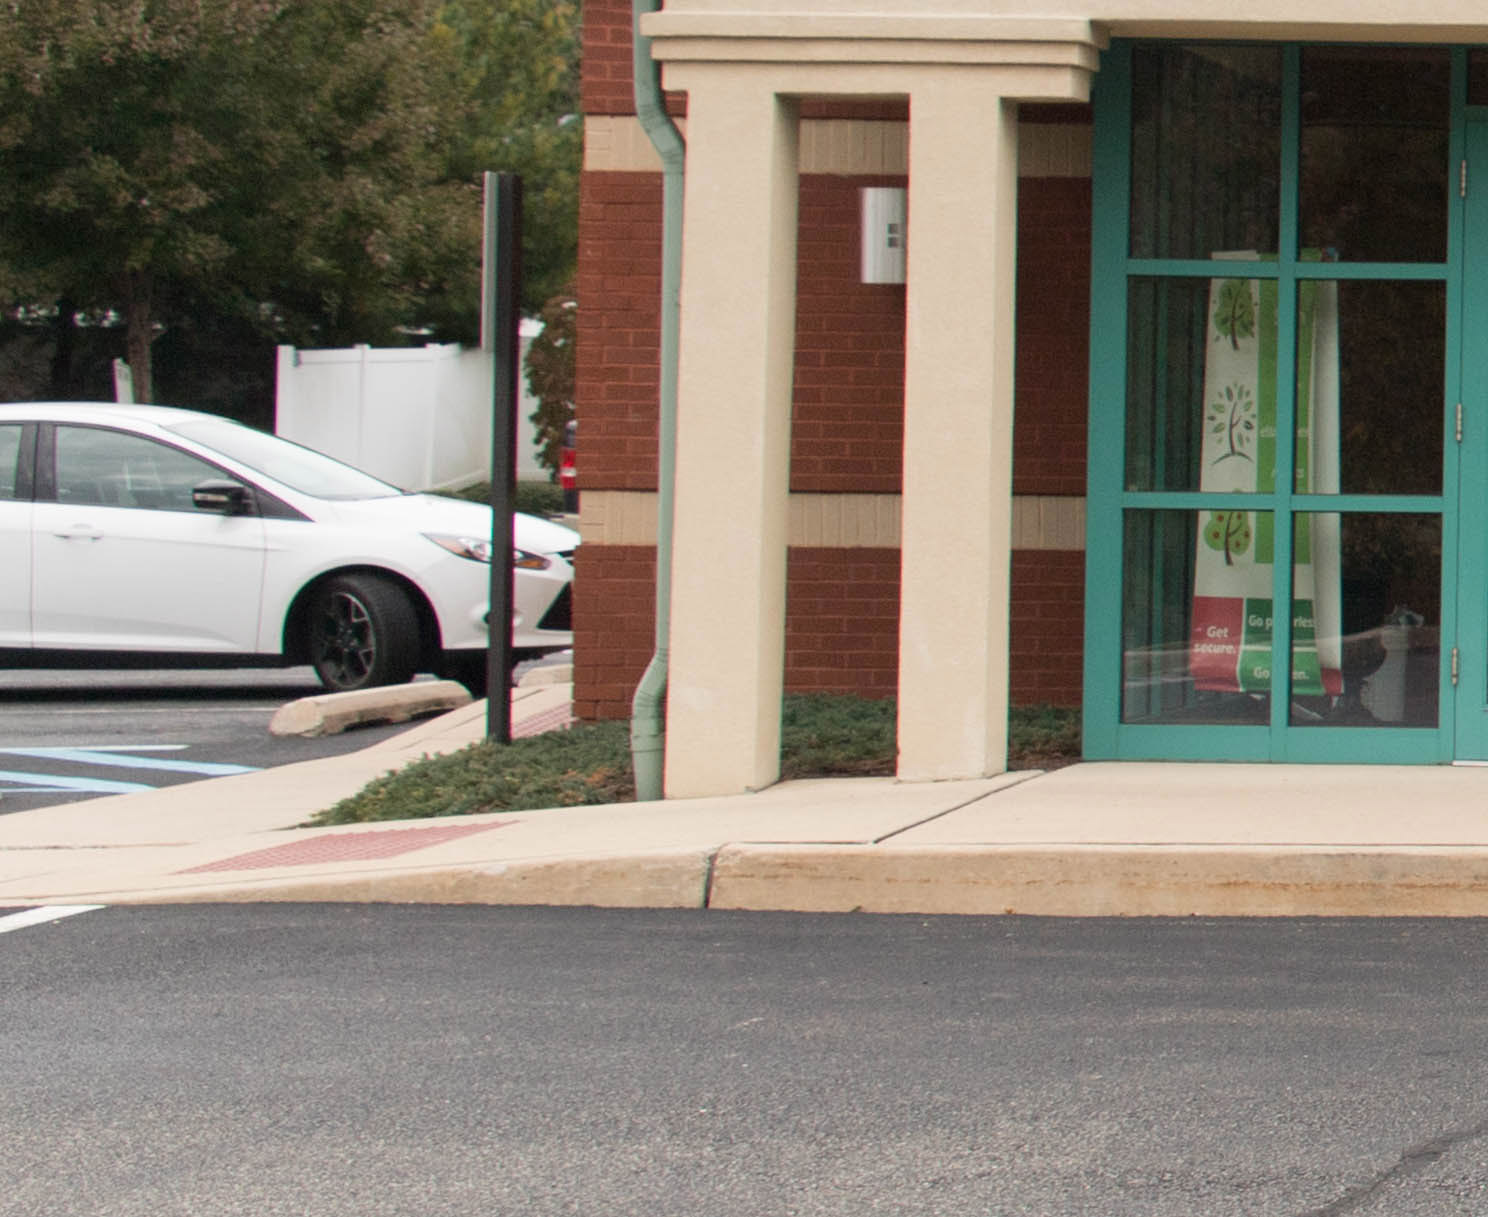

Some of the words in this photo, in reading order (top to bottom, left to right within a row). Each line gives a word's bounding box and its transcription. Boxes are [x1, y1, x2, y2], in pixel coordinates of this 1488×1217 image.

[1248, 615, 1263, 626] Go
[1206, 626, 1229, 638] Get
[1194, 642, 1236, 655] secure.
[1253, 667, 1270, 679] Go
